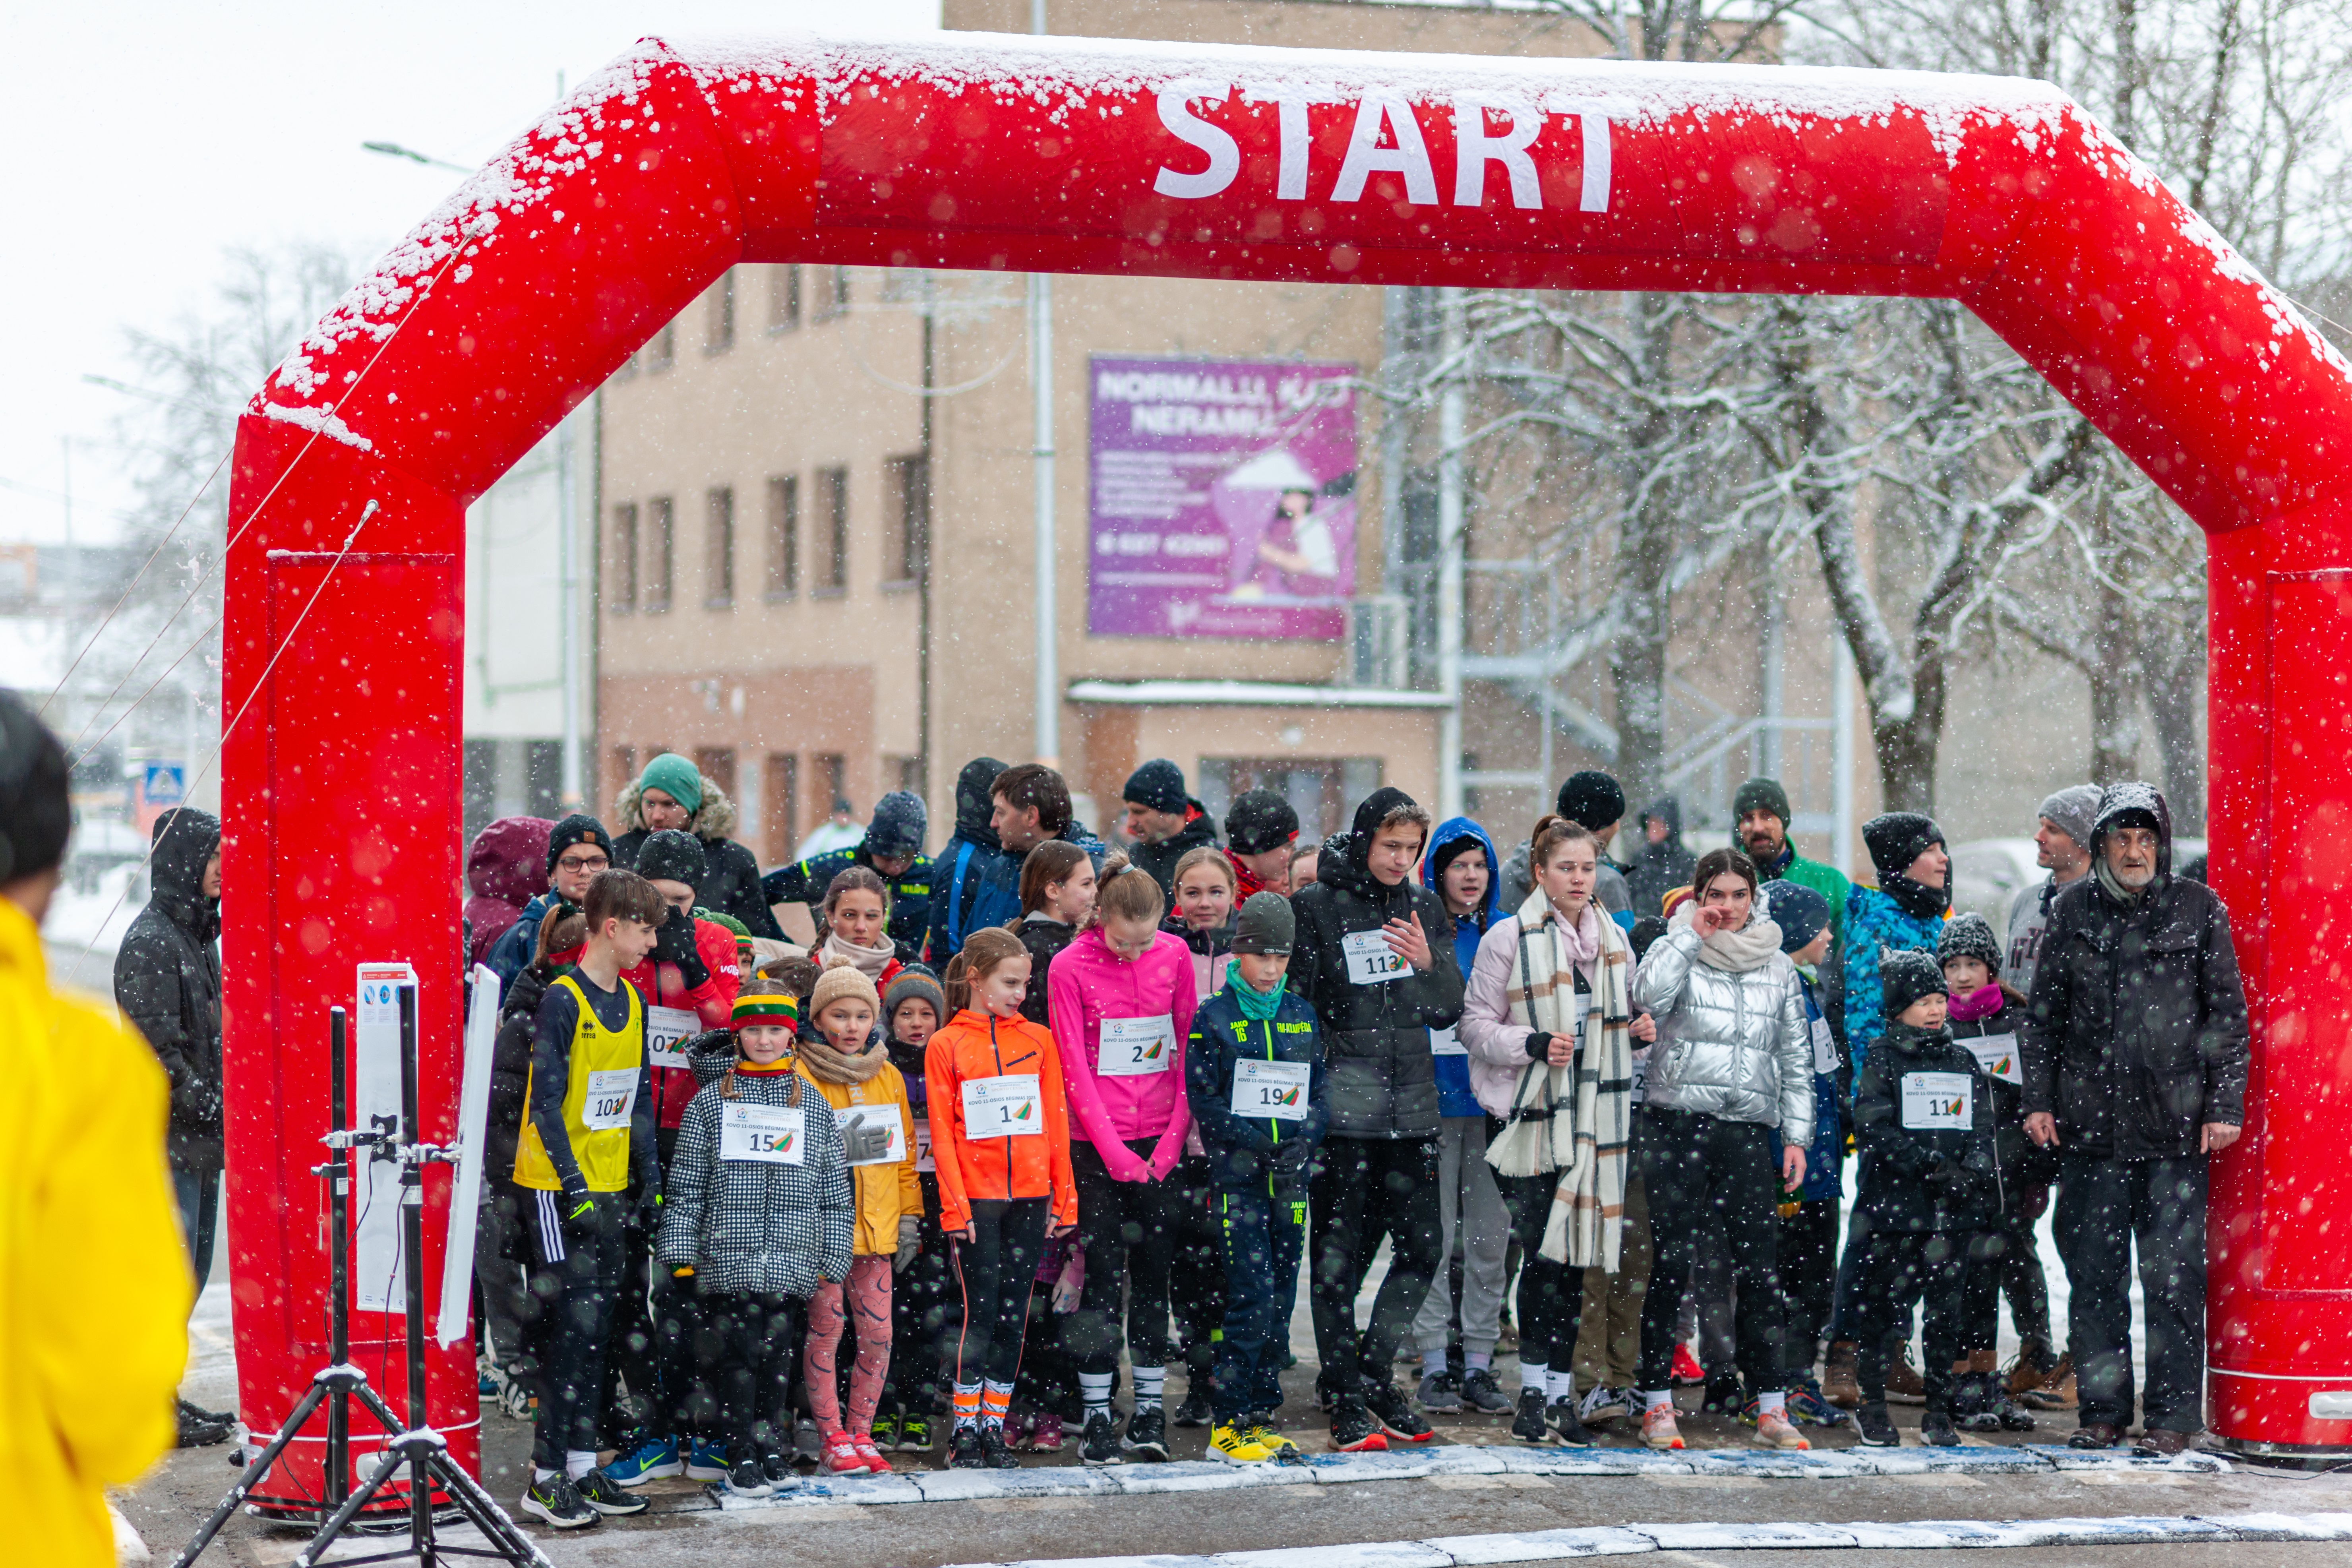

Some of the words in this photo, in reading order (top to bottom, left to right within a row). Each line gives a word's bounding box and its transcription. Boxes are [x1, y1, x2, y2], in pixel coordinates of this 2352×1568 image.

[1153, 77, 1611, 213] START
[2009, 927, 2044, 969] NY
[1366, 955, 1399, 974] 113
[1230, 1020, 1248, 1030] JAKO
[648, 1035, 678, 1053] 07
[1235, 1028, 1247, 1043] 16
[1132, 1045, 1142, 1063] 2
[1635, 1073, 1644, 1090] 2
[1260, 1087, 1283, 1105] 19
[595, 1098, 620, 1117] 101
[1000, 1105, 1012, 1123] 1
[1930, 1099, 1951, 1116] 11
[750, 1134, 774, 1152] 15
[918, 1143, 929, 1160] 7
[1293, 1209, 1303, 1224] 16
